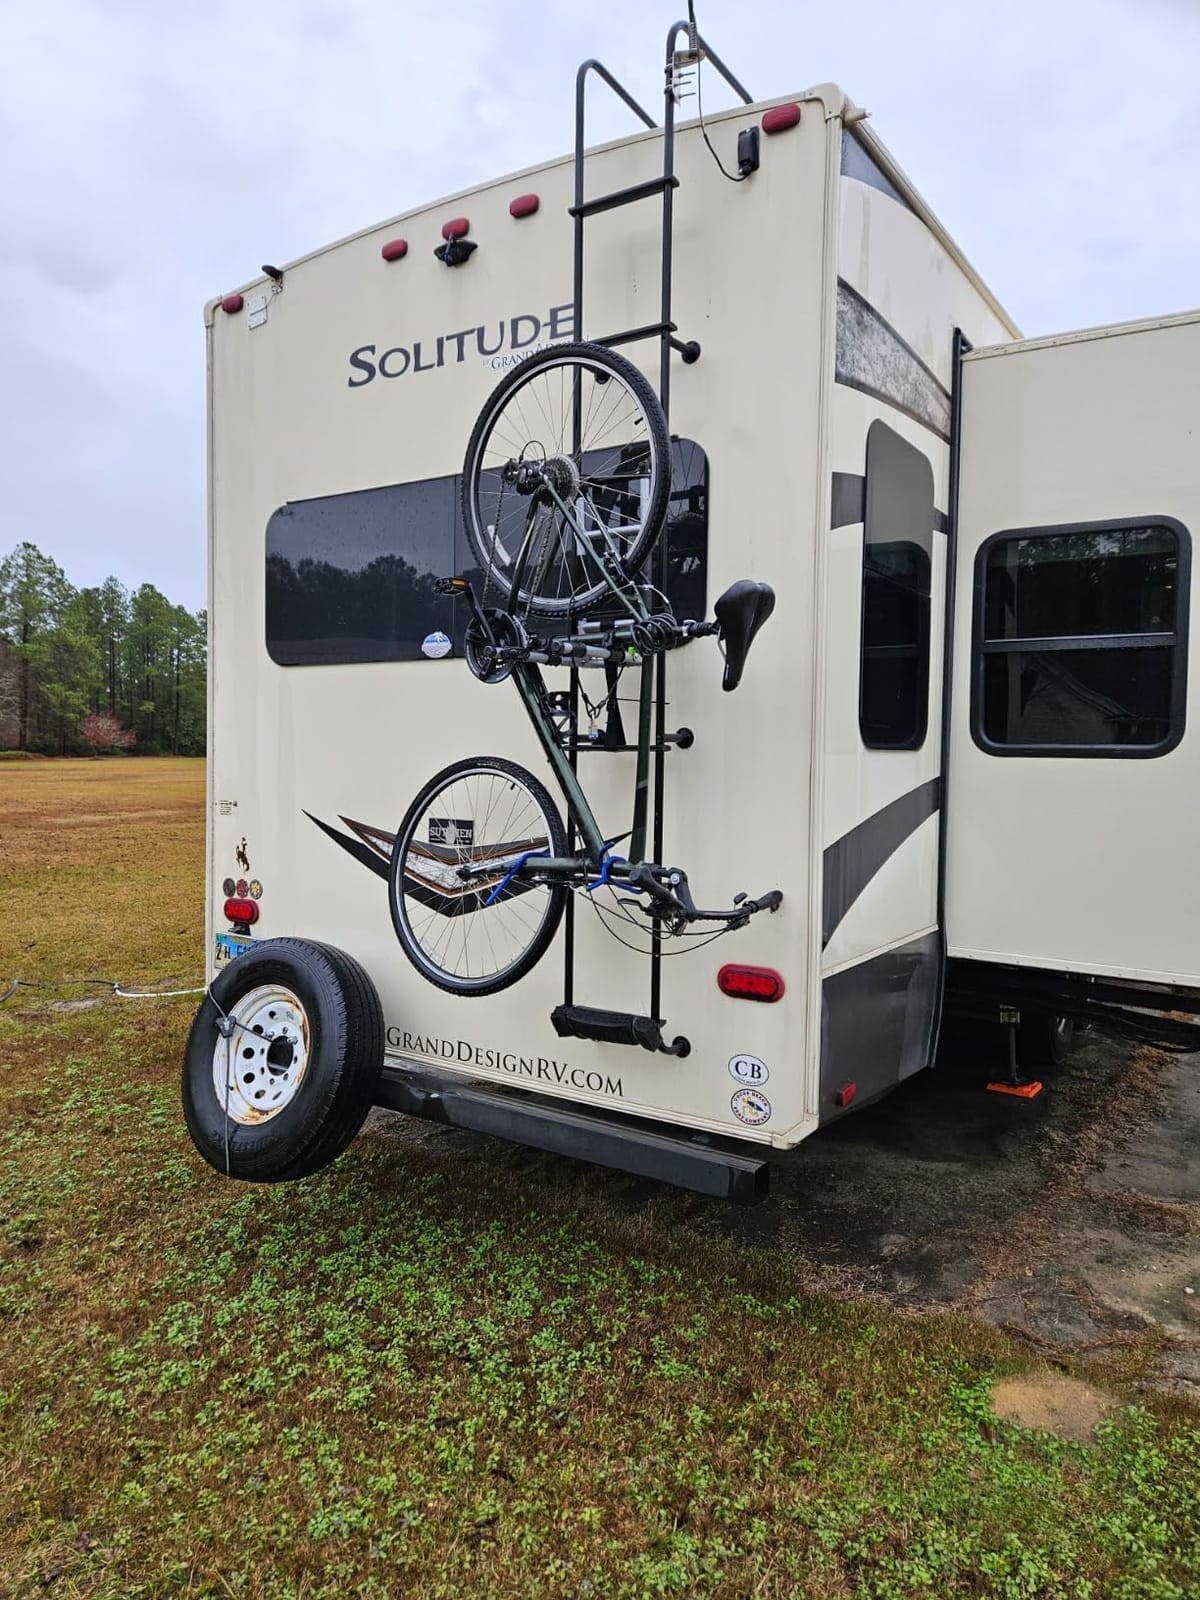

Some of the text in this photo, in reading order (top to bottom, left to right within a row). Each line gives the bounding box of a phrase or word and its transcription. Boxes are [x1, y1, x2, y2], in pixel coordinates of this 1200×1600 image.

[348, 303, 574, 387] SOLITUDE
[386, 1026, 624, 1097] GRANDDESIGNRV.COM
[734, 1060, 762, 1079] CB
